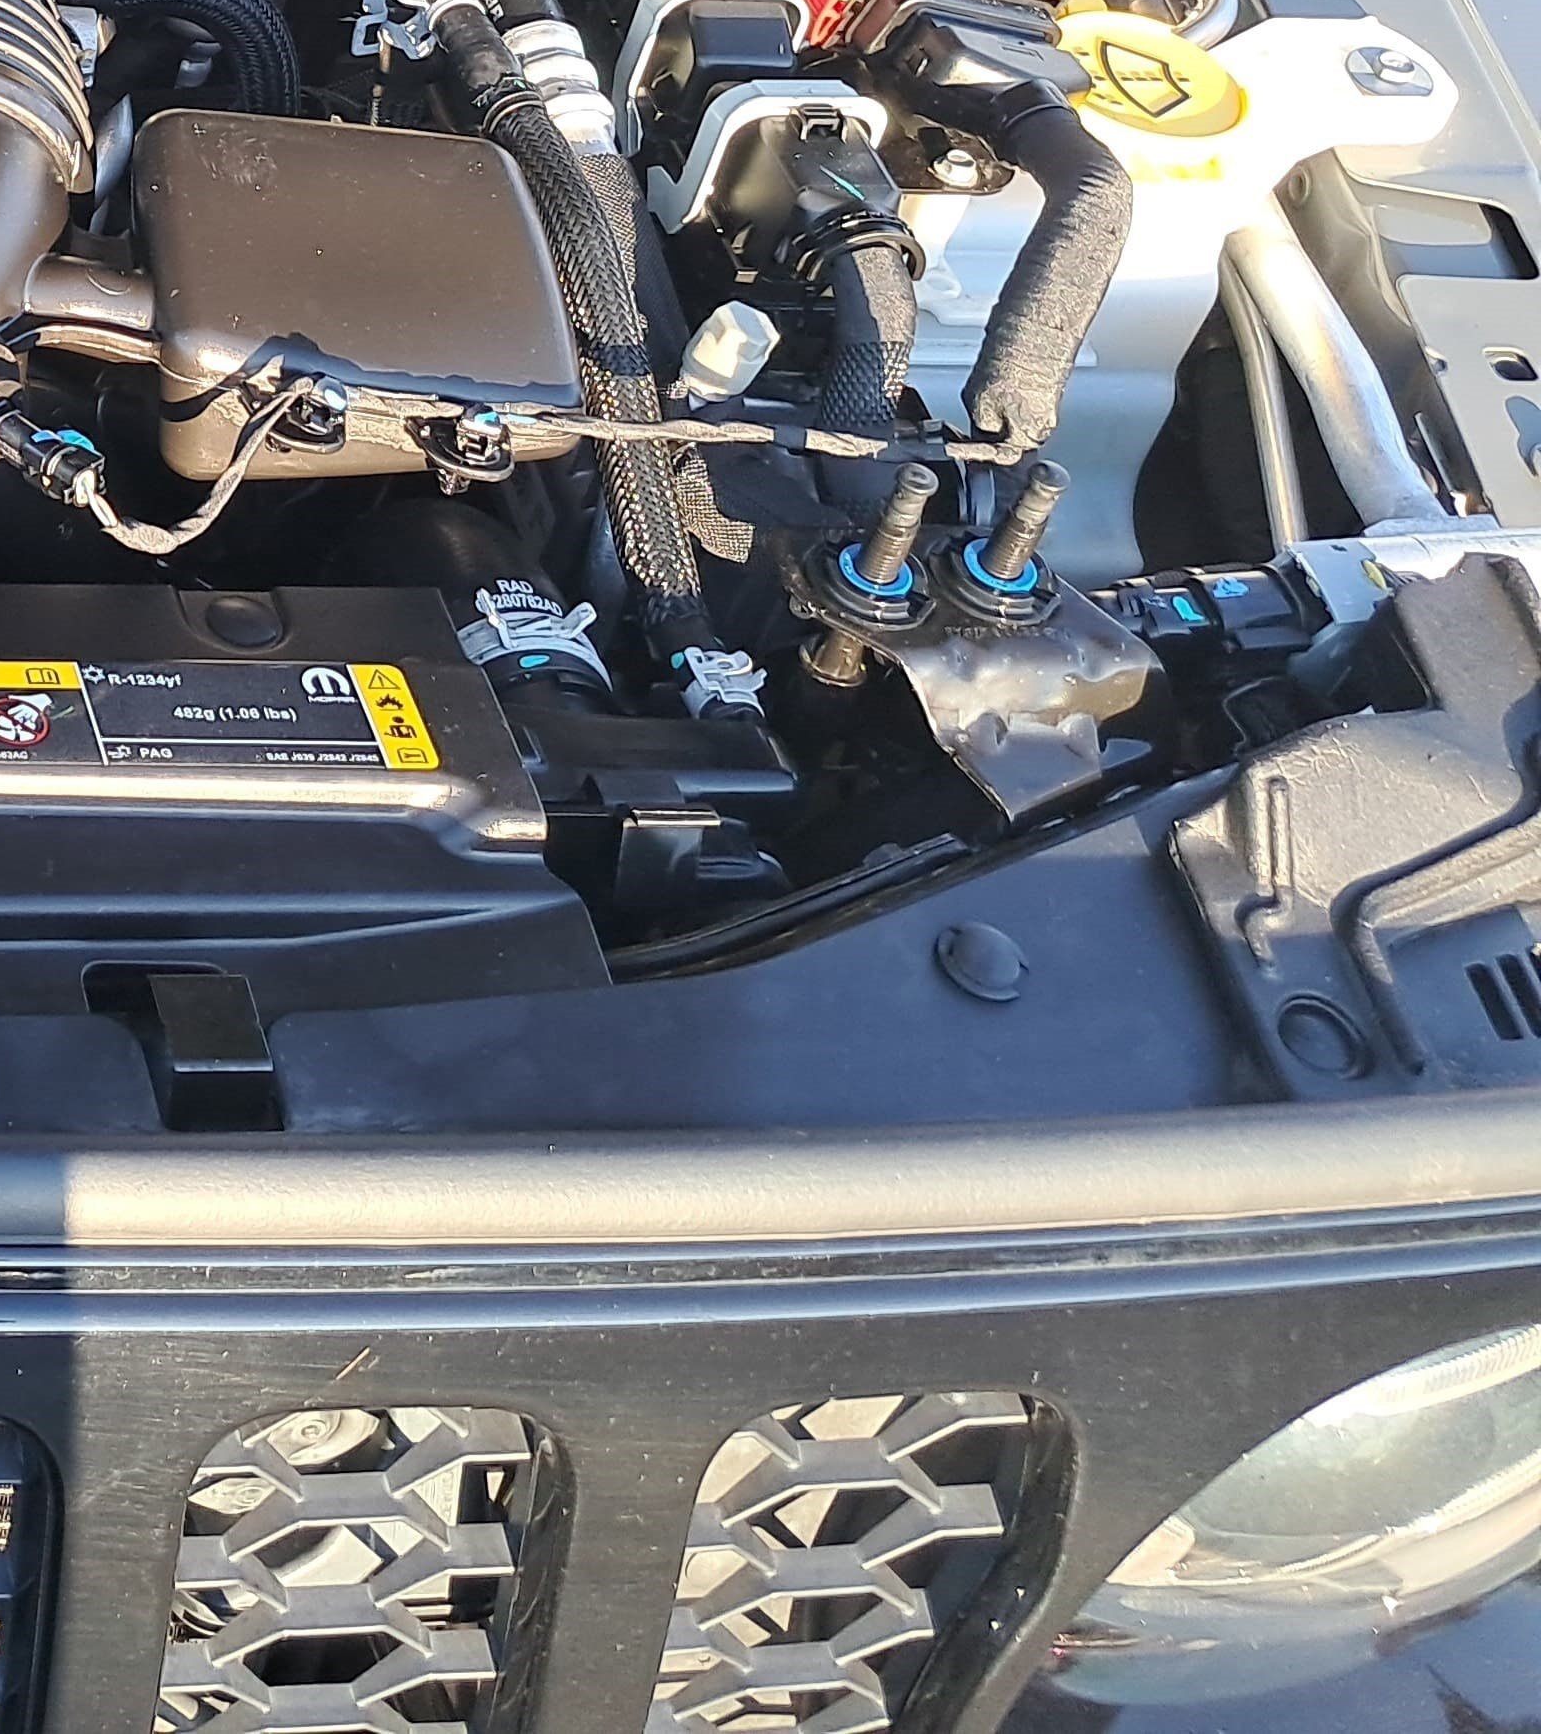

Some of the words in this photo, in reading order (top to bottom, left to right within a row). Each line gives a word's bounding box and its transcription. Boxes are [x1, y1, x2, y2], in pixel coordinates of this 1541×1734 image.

[495, 579, 534, 594] RAD
[107, 673, 182, 688] R-1234yf
[263, 706, 298, 723] lbs)
[139, 747, 173, 759] PAG
